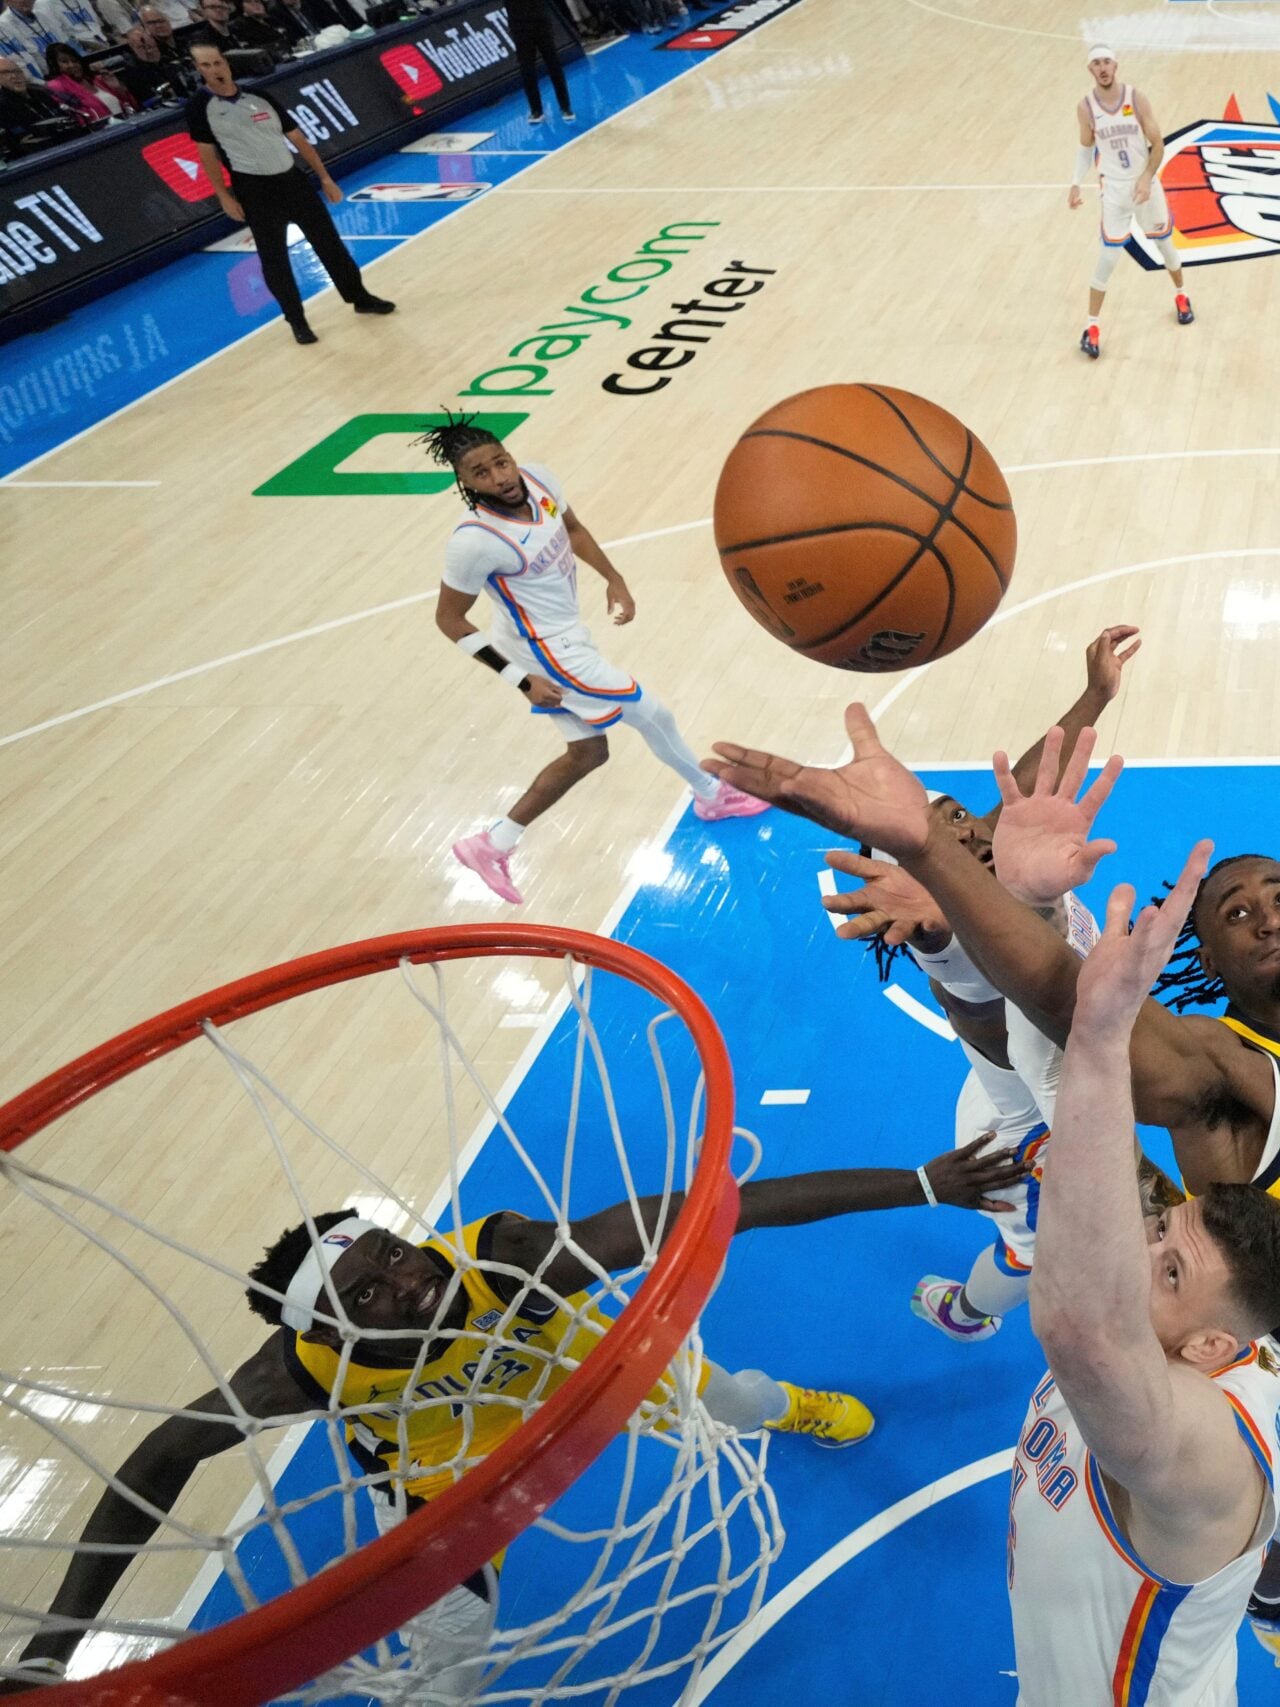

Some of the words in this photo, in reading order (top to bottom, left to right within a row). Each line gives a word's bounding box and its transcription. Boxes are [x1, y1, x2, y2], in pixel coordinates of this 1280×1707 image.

[416, 22, 509, 82] YouTube
[299, 78, 359, 132] TV
[1118, 149, 1131, 169] 9
[14, 185, 104, 252] TV
[0, 221, 57, 285] be
[457, 221, 721, 396] paycom
[601, 260, 777, 395] center
